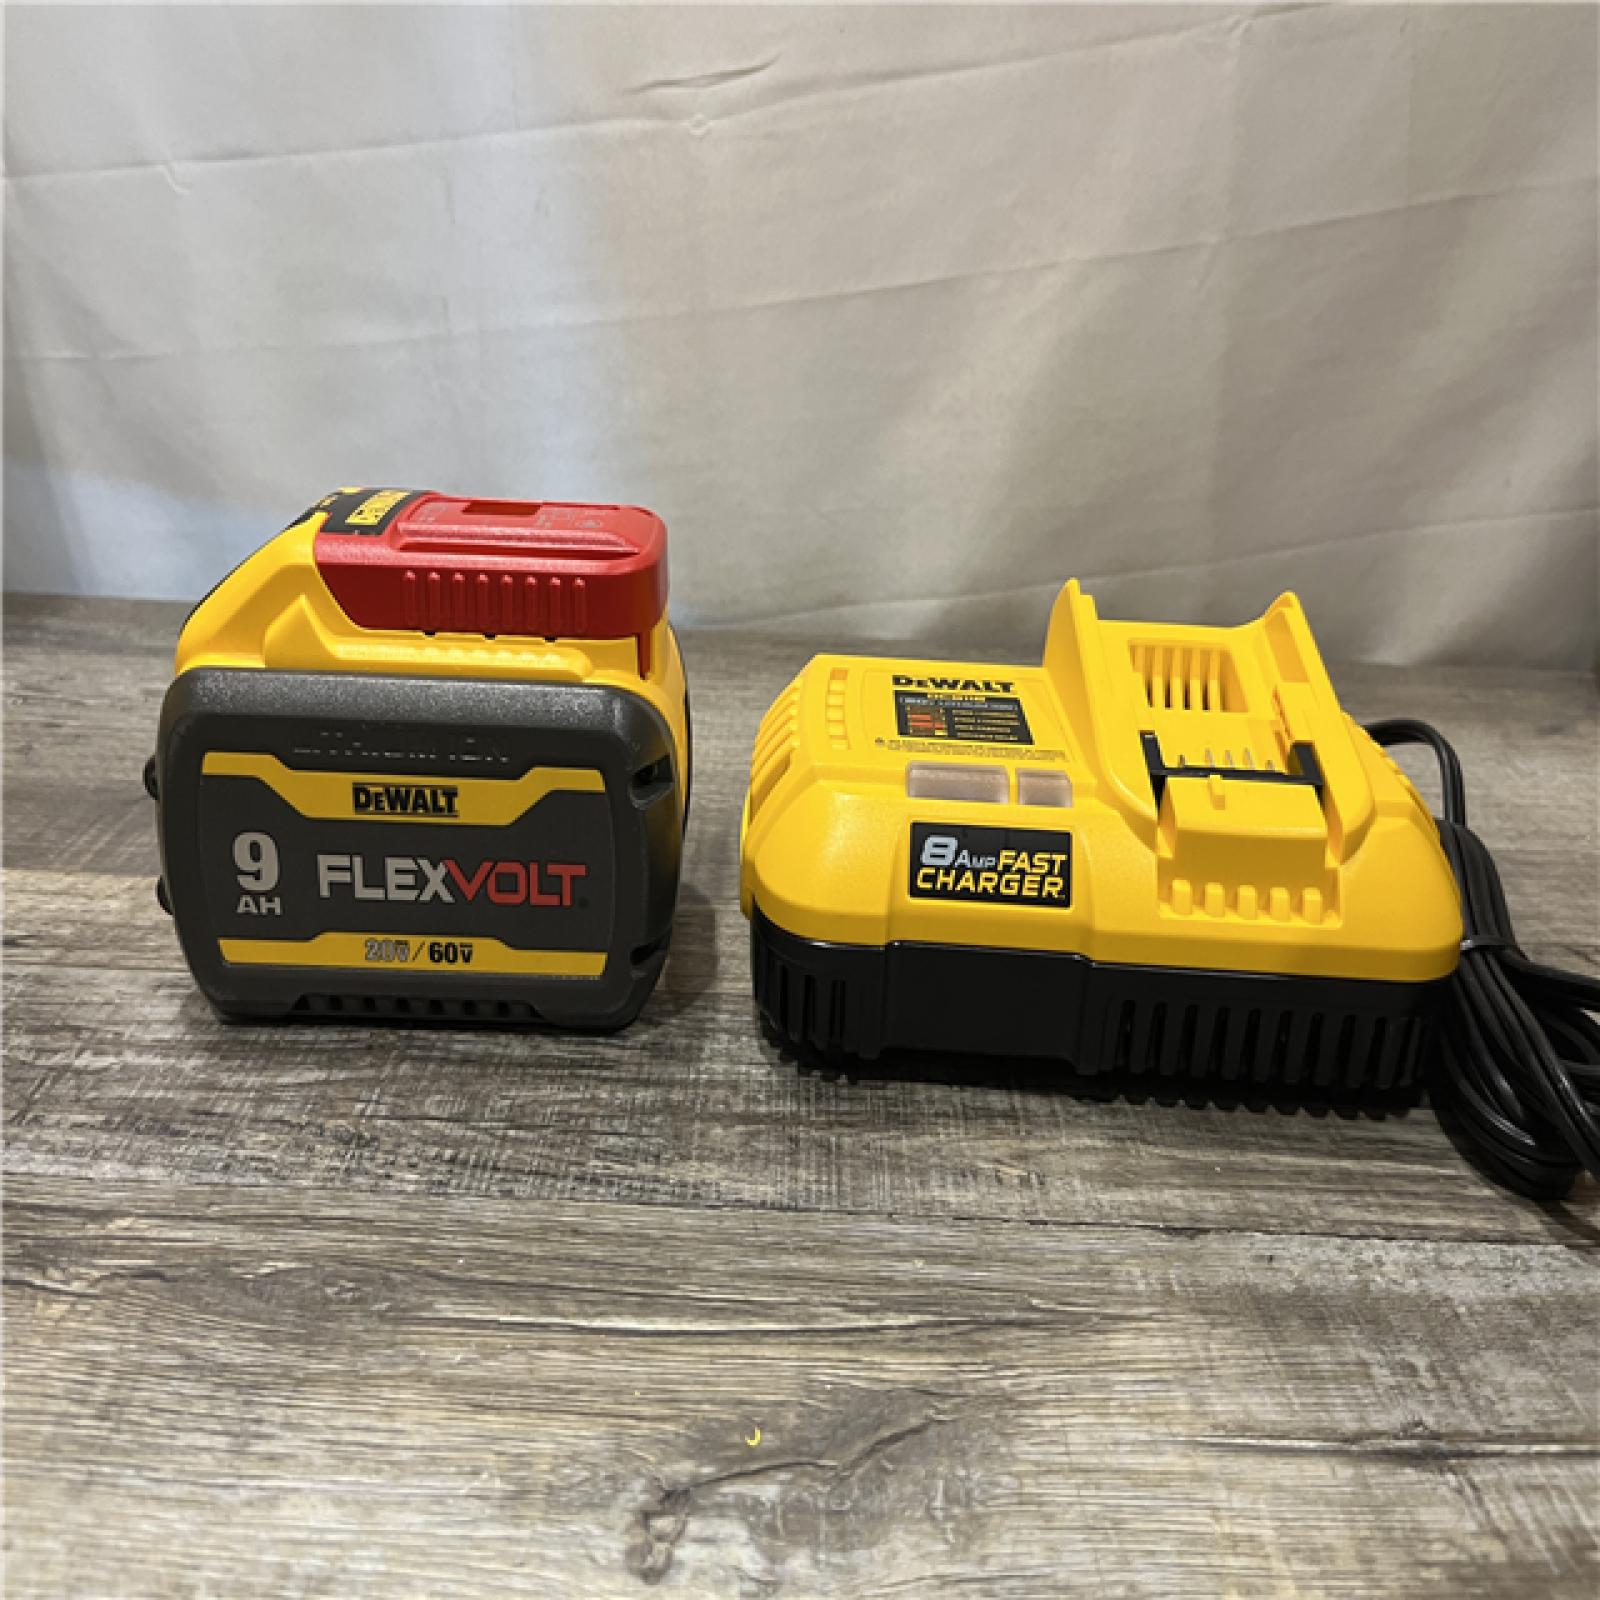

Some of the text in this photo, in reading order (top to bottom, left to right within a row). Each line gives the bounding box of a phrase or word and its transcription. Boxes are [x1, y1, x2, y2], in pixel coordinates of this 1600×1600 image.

[232, 831, 281, 892] 9
[921, 834, 958, 866] 8
[997, 849, 1068, 876] FAST
[317, 853, 588, 907] FLEXVOLT
[916, 866, 1065, 899] CHARGER
[236, 894, 282, 916] AH
